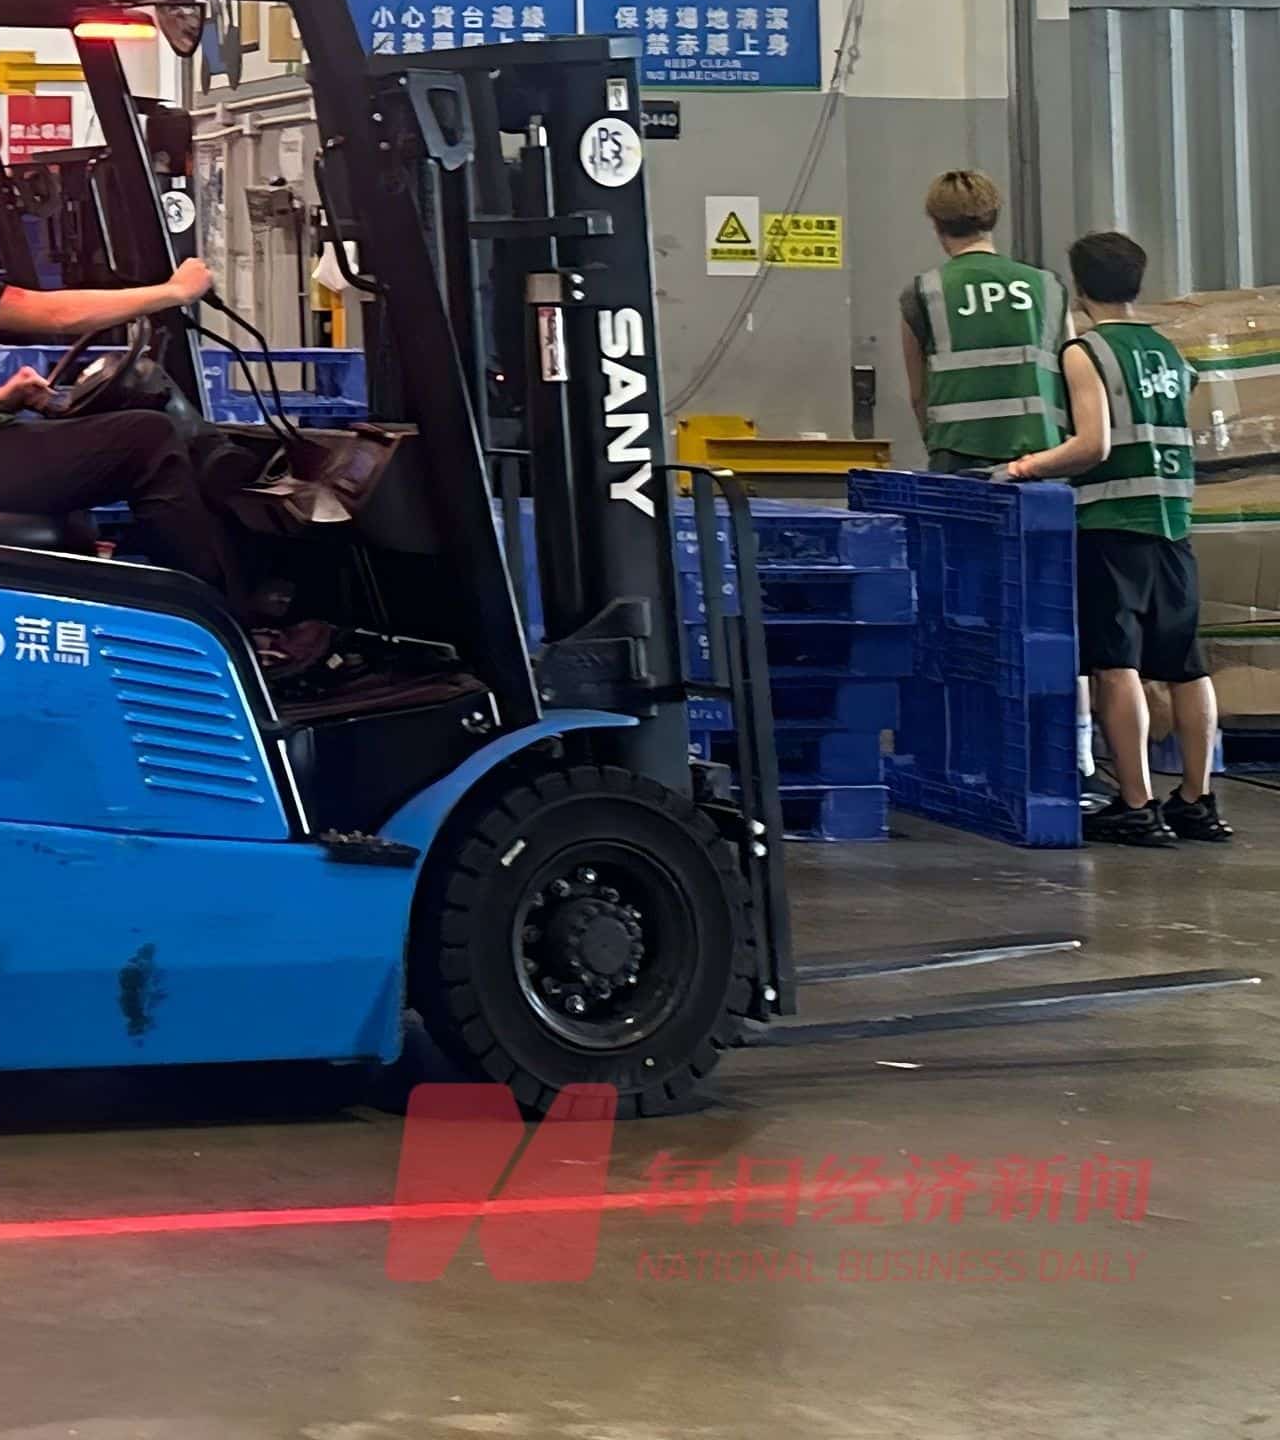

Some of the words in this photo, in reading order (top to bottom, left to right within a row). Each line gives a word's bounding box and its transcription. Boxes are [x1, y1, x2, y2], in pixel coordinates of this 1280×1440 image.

[958, 280, 1033, 317] JPS
[598, 308, 656, 518] SANY
[14, 615, 90, 667] 菜鳥
